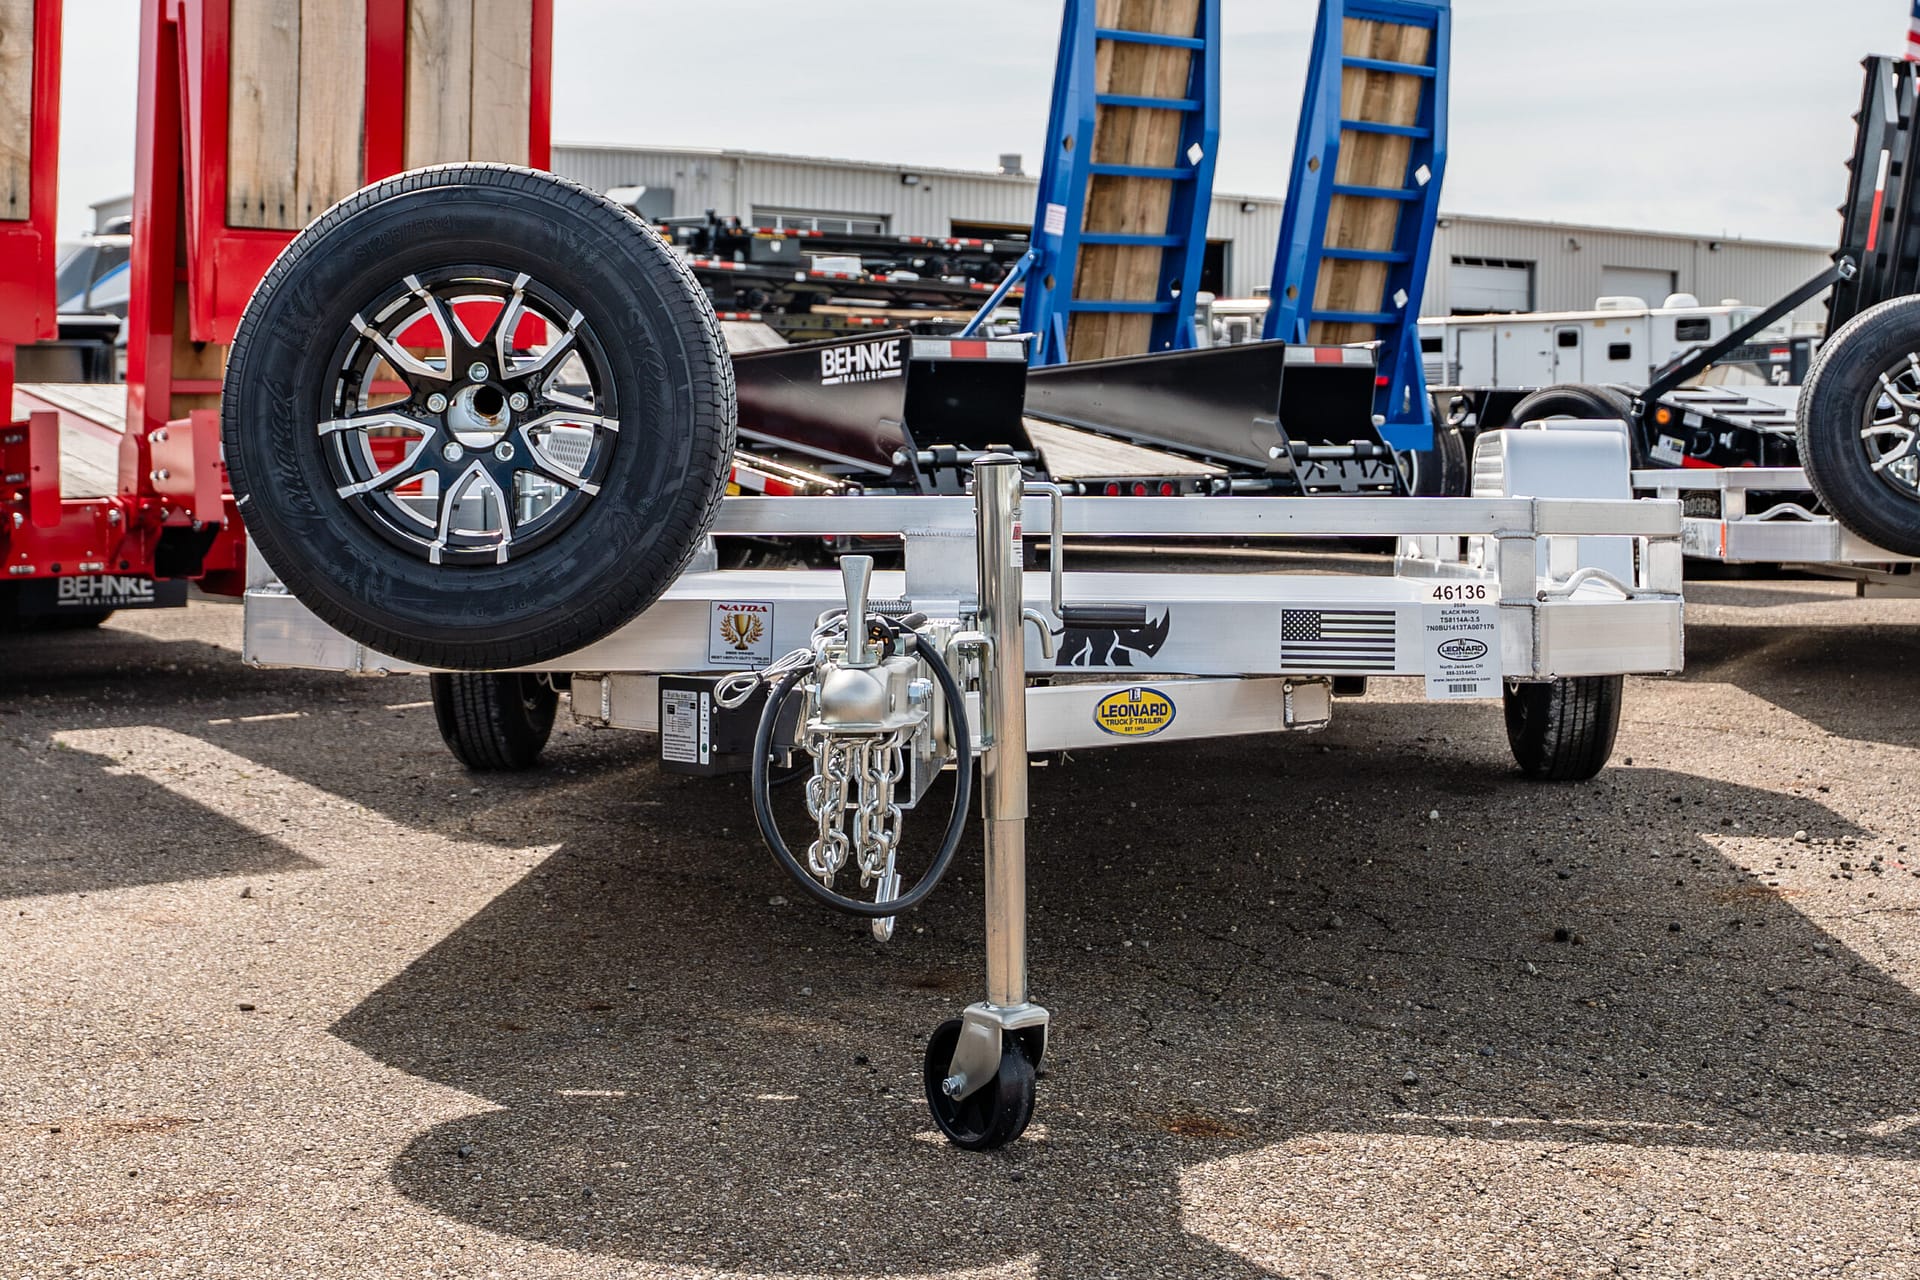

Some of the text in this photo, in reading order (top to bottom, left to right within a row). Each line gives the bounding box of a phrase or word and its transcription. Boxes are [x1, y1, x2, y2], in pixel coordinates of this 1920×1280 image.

[821, 339, 902, 377] BEHNKE
[58, 574, 155, 598] BEHNKE
[1432, 584, 1486, 600] 46136
[717, 604, 768, 613] NATDA
[1441, 645, 1483, 653] LEONARD
[1101, 703, 1168, 718] LEONARD
[1134, 717, 1163, 725] TRAILER
